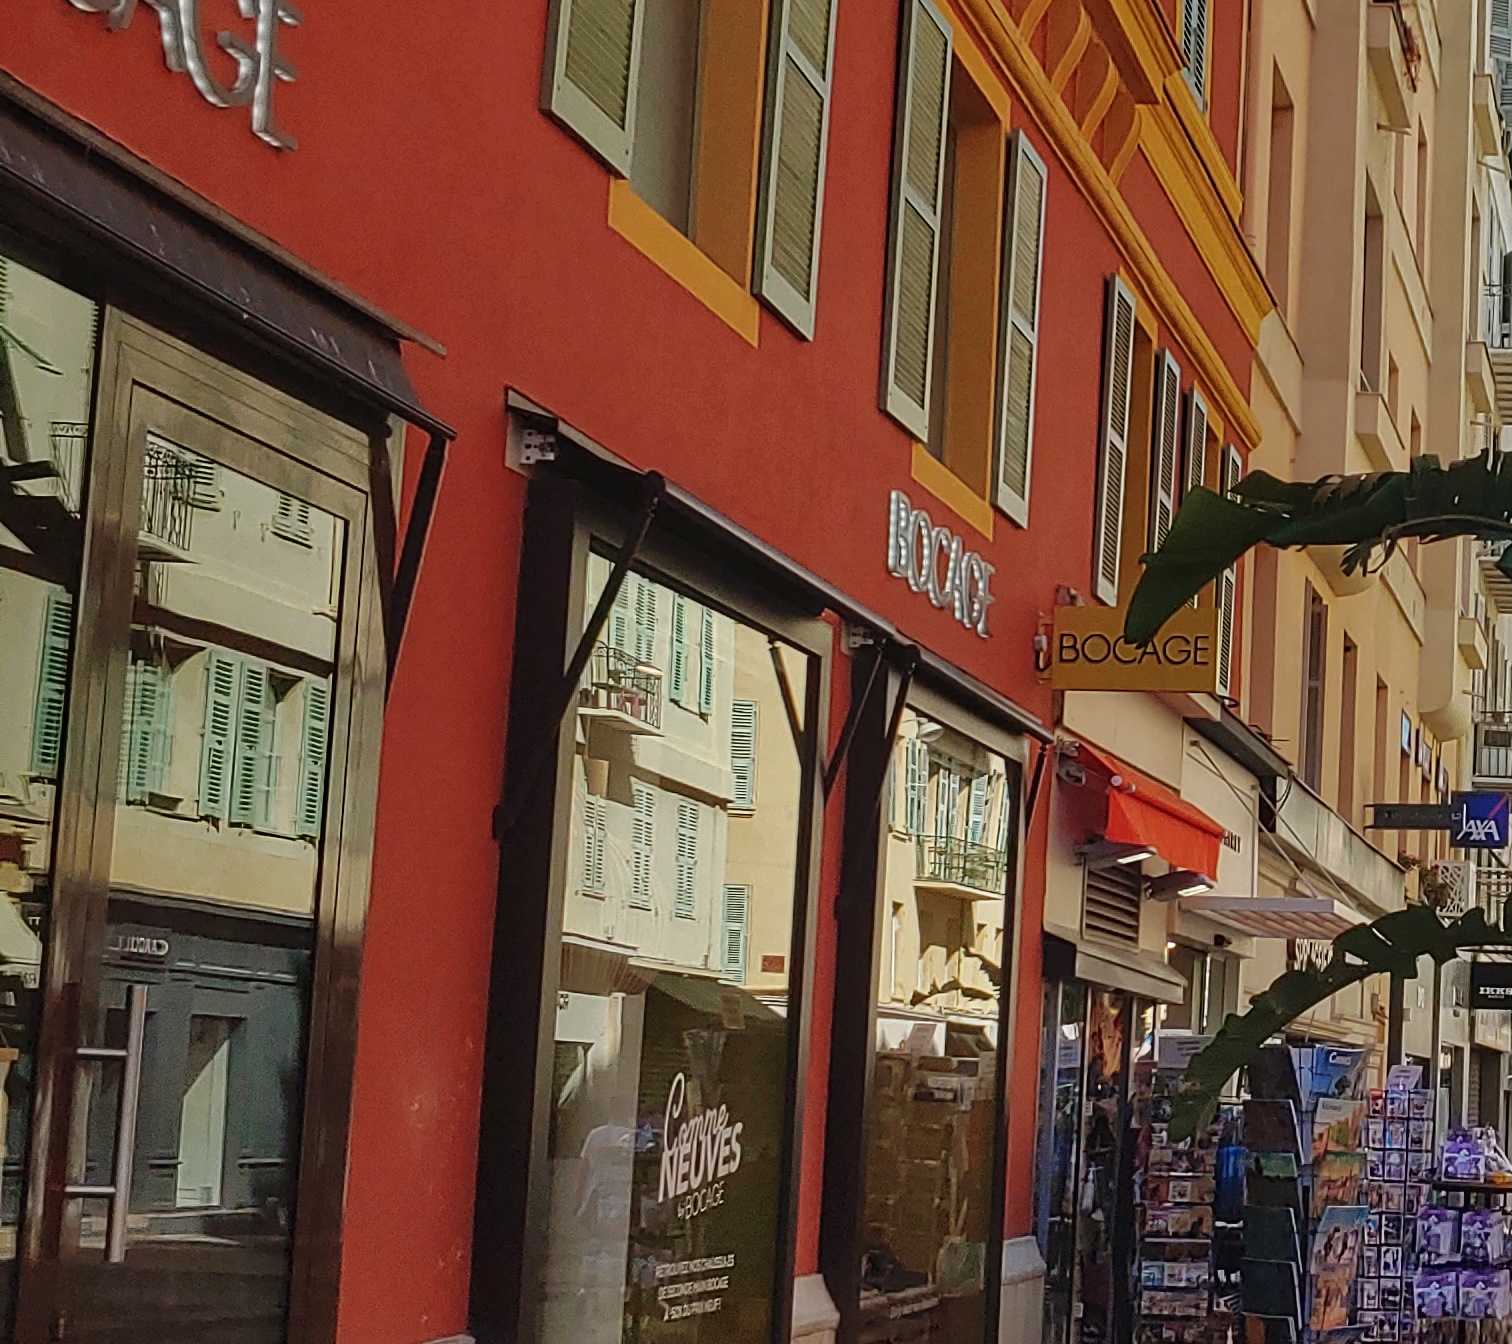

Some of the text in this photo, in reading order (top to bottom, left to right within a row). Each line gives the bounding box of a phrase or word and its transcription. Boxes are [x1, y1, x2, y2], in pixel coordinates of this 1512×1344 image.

[887, 489, 997, 639] BOCAGE
[1059, 633, 1210, 665] BOCAGE
[1464, 819, 1500, 841] AXA
[664, 1072, 729, 1155] Comme
[657, 1122, 743, 1204] NEUVES
[685, 1180, 725, 1220] BOCAGE
